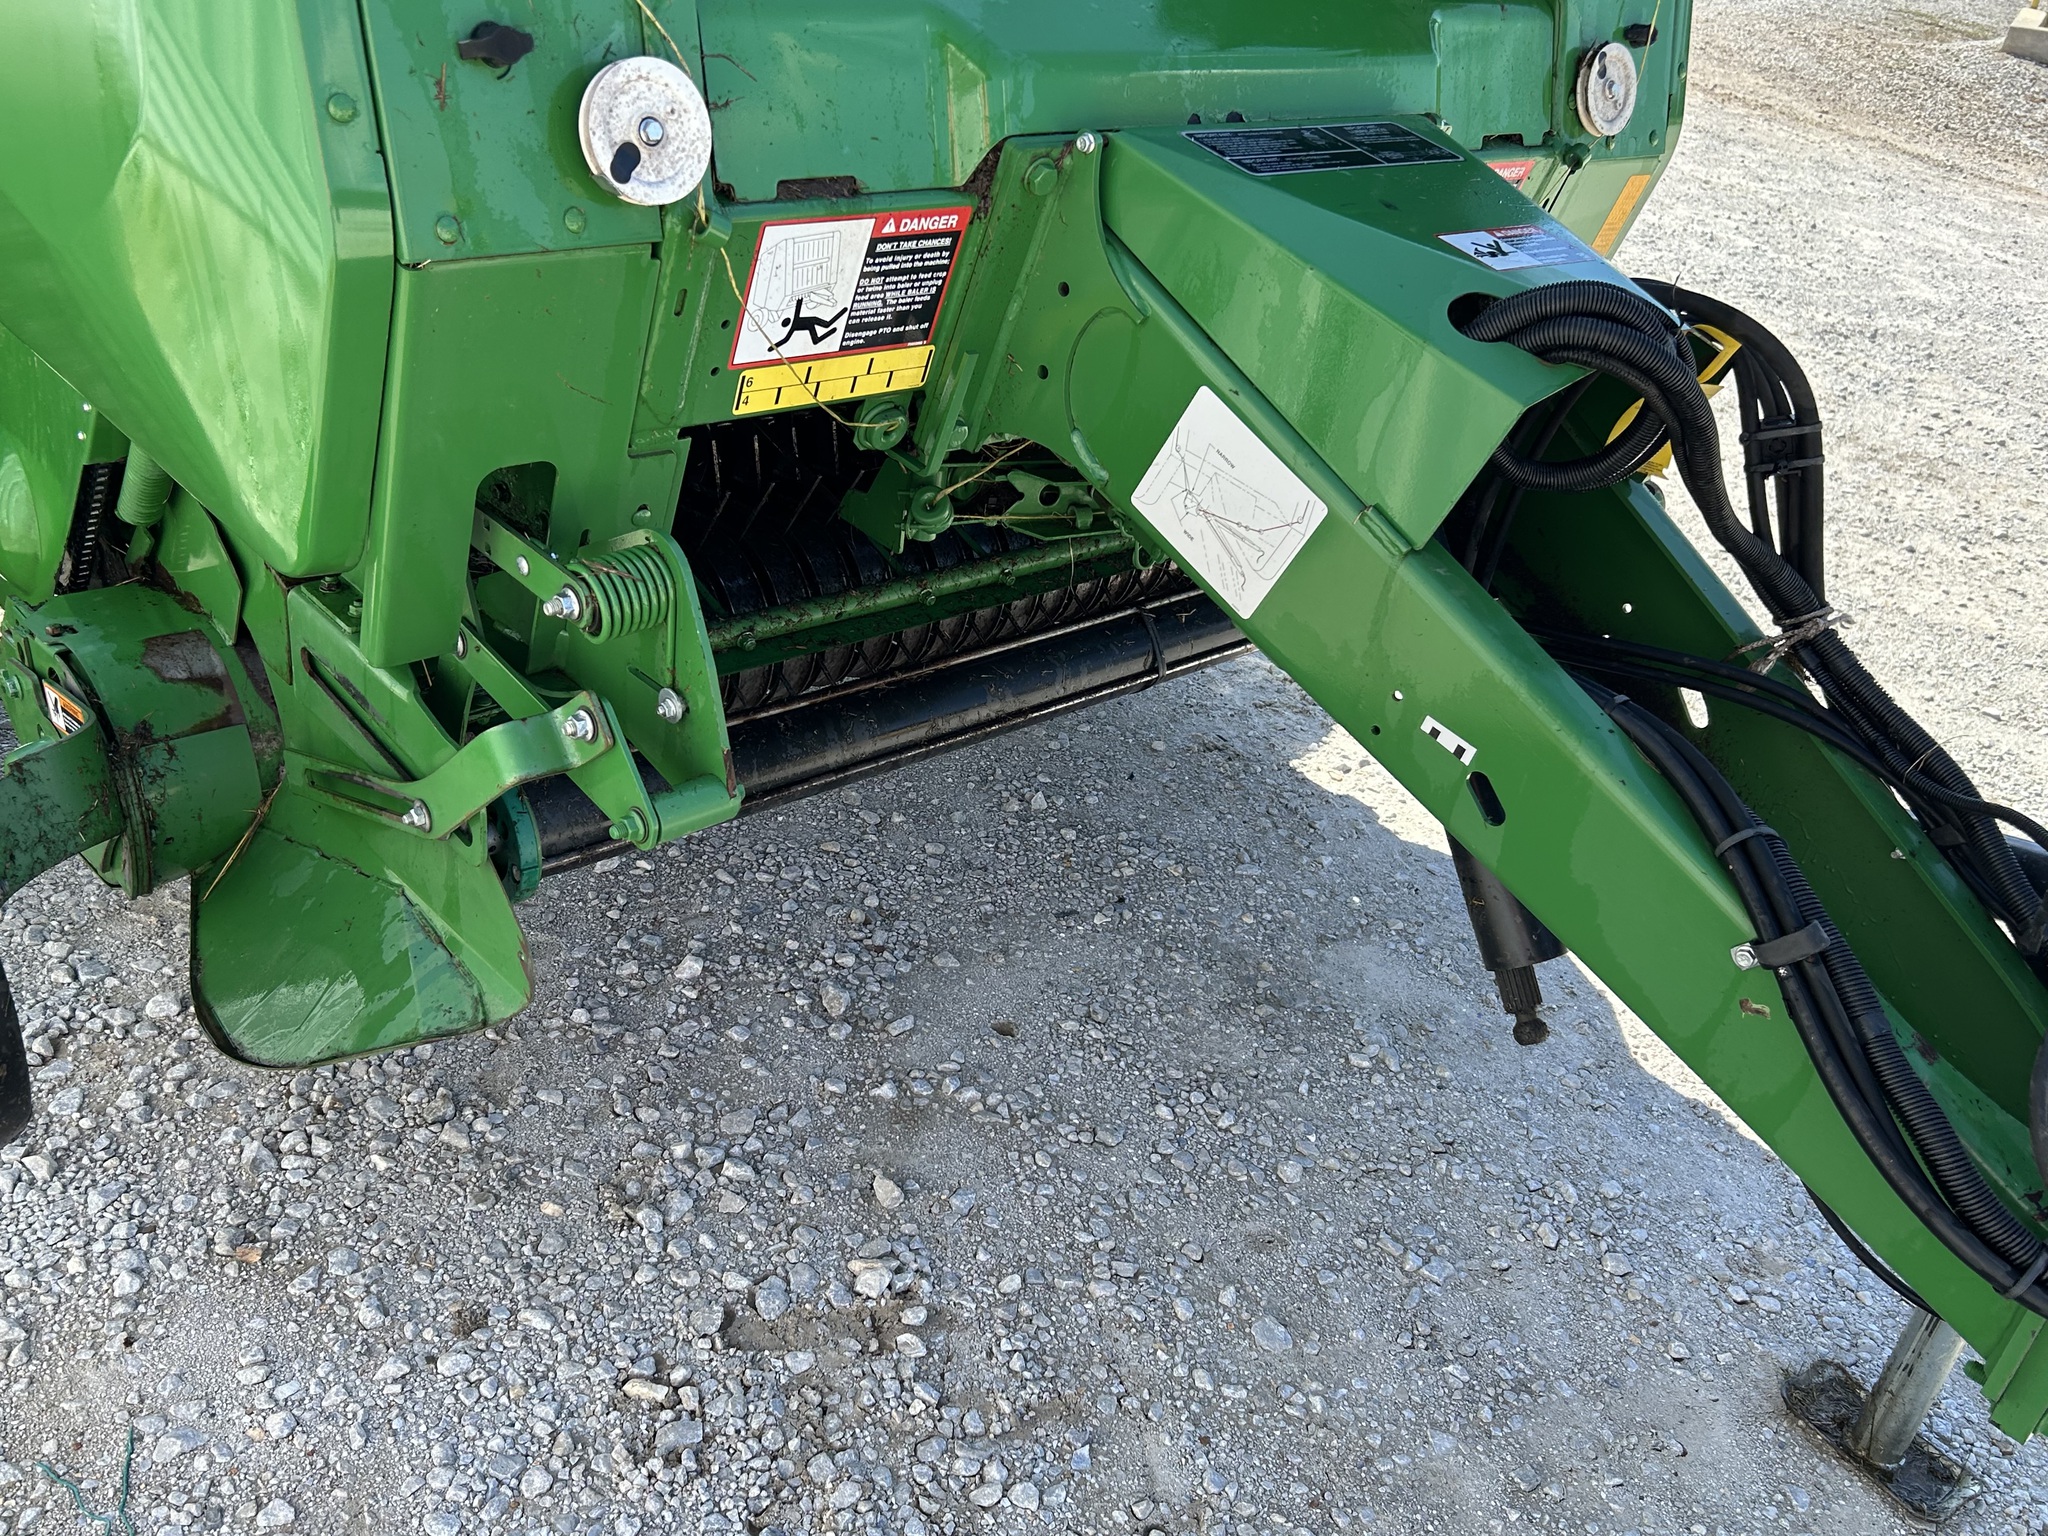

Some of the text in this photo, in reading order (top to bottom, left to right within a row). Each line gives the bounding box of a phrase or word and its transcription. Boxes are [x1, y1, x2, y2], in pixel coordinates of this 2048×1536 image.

[899, 215, 959, 232] DANGER
[876, 236, 953, 252] DON'T TAKE CHANCES!
[874, 255, 893, 263] avoid
[893, 254, 913, 262] injury
[922, 251, 940, 259] death
[941, 250, 950, 258] by
[862, 265, 880, 273] being
[880, 262, 901, 272] pulled
[900, 261, 913, 269] into
[859, 278, 870, 287] DO
[870, 276, 885, 286] NOT
[885, 274, 909, 283] attempt
[918, 271, 932, 279] feed
[865, 285, 883, 293] twine
[896, 281, 913, 289] baler
[885, 289, 907, 299] WHILE
[907, 287, 929, 297] BALER
[929, 286, 937, 295] IS
[850, 308, 876, 317] material
[876, 306, 895, 314] faster
[910, 303, 923, 311] you
[861, 315, 885, 323] release
[844, 329, 878, 339] Disengage
[878, 326, 892, 335] PTO
[892, 325, 905, 333] and
[746, 376, 754, 388] 6
[741, 395, 750, 406] 4
[1216, 448, 1236, 469] NARROW
